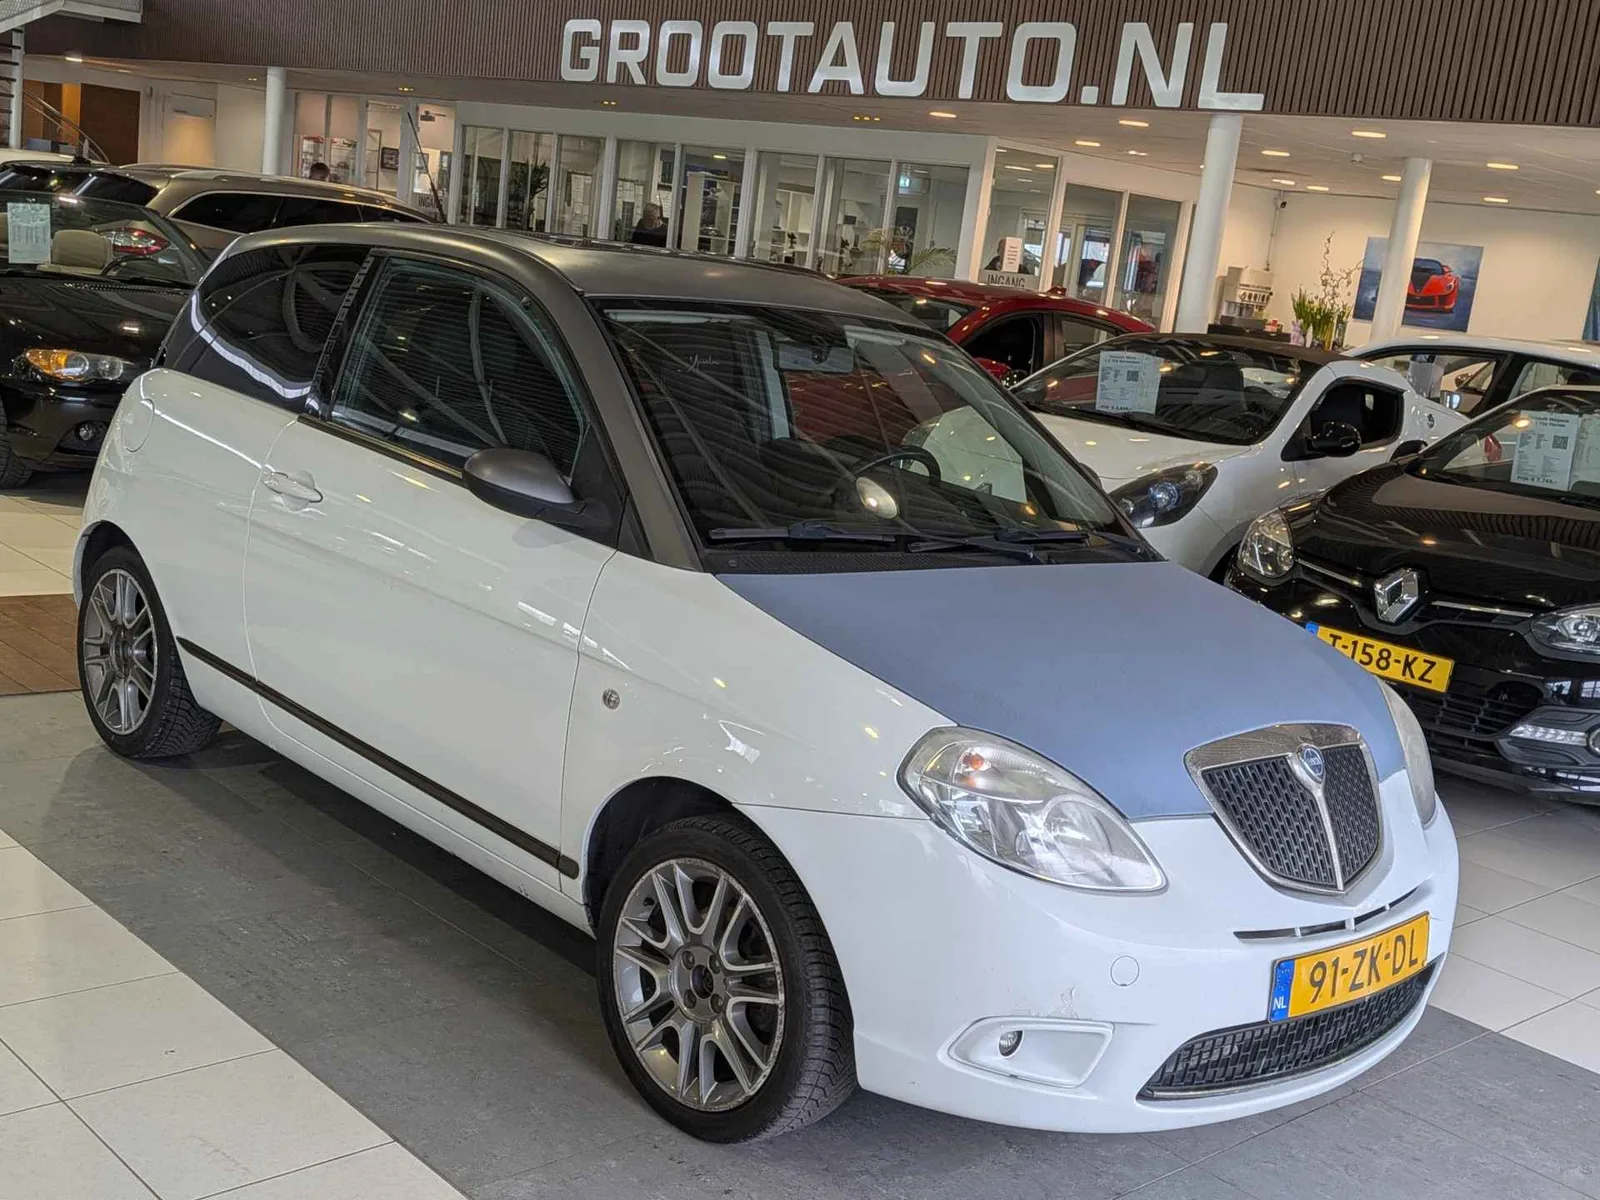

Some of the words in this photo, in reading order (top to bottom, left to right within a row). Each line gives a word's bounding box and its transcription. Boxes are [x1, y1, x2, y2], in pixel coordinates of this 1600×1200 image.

[561, 19, 1265, 110] GROOTAUTO.NL
[418, 195, 443, 209] INGA
[988, 274, 1026, 288] INGANG
[1329, 633, 1437, 684] T-158-KZ
[1309, 929, 1419, 1004] 91-ZK-DL
[1272, 995, 1287, 1010] NL
